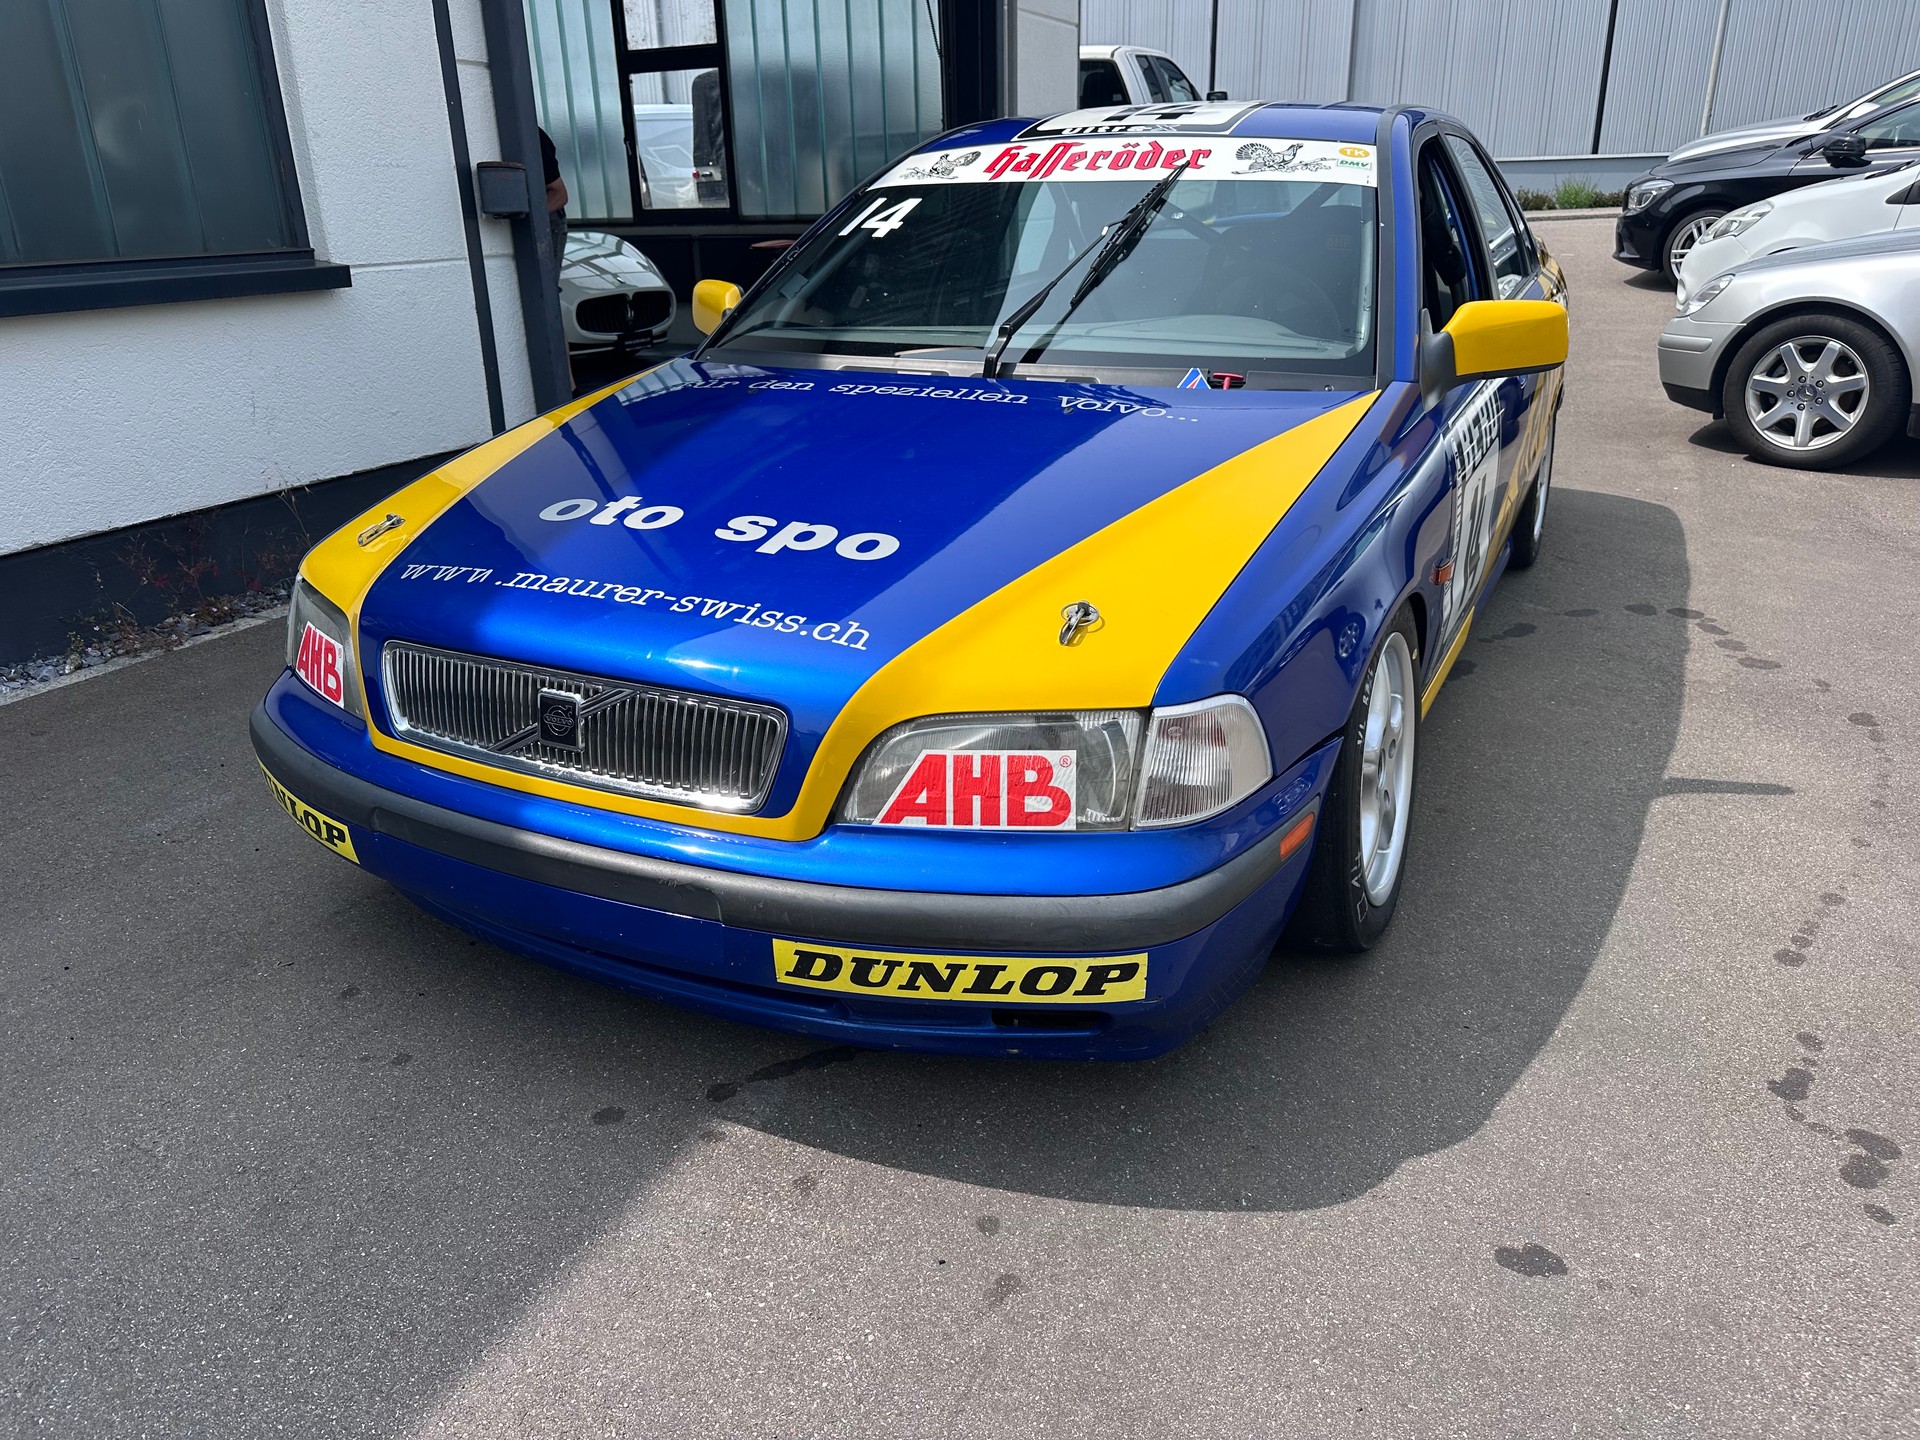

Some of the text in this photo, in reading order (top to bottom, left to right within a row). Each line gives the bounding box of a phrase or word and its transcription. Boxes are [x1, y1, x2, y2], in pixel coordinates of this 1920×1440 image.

[1339, 159, 1369, 168] DMV
[1343, 148, 1366, 157] TK
[838, 197, 923, 238] 14
[748, 379, 816, 392] den
[829, 382, 1028, 405] speziellen
[539, 495, 901, 561] oto spo
[400, 564, 870, 651] www.maurer-swiss.ch
[546, 715, 573, 726] VOLVO
[784, 949, 1140, 997] DUNLOP
